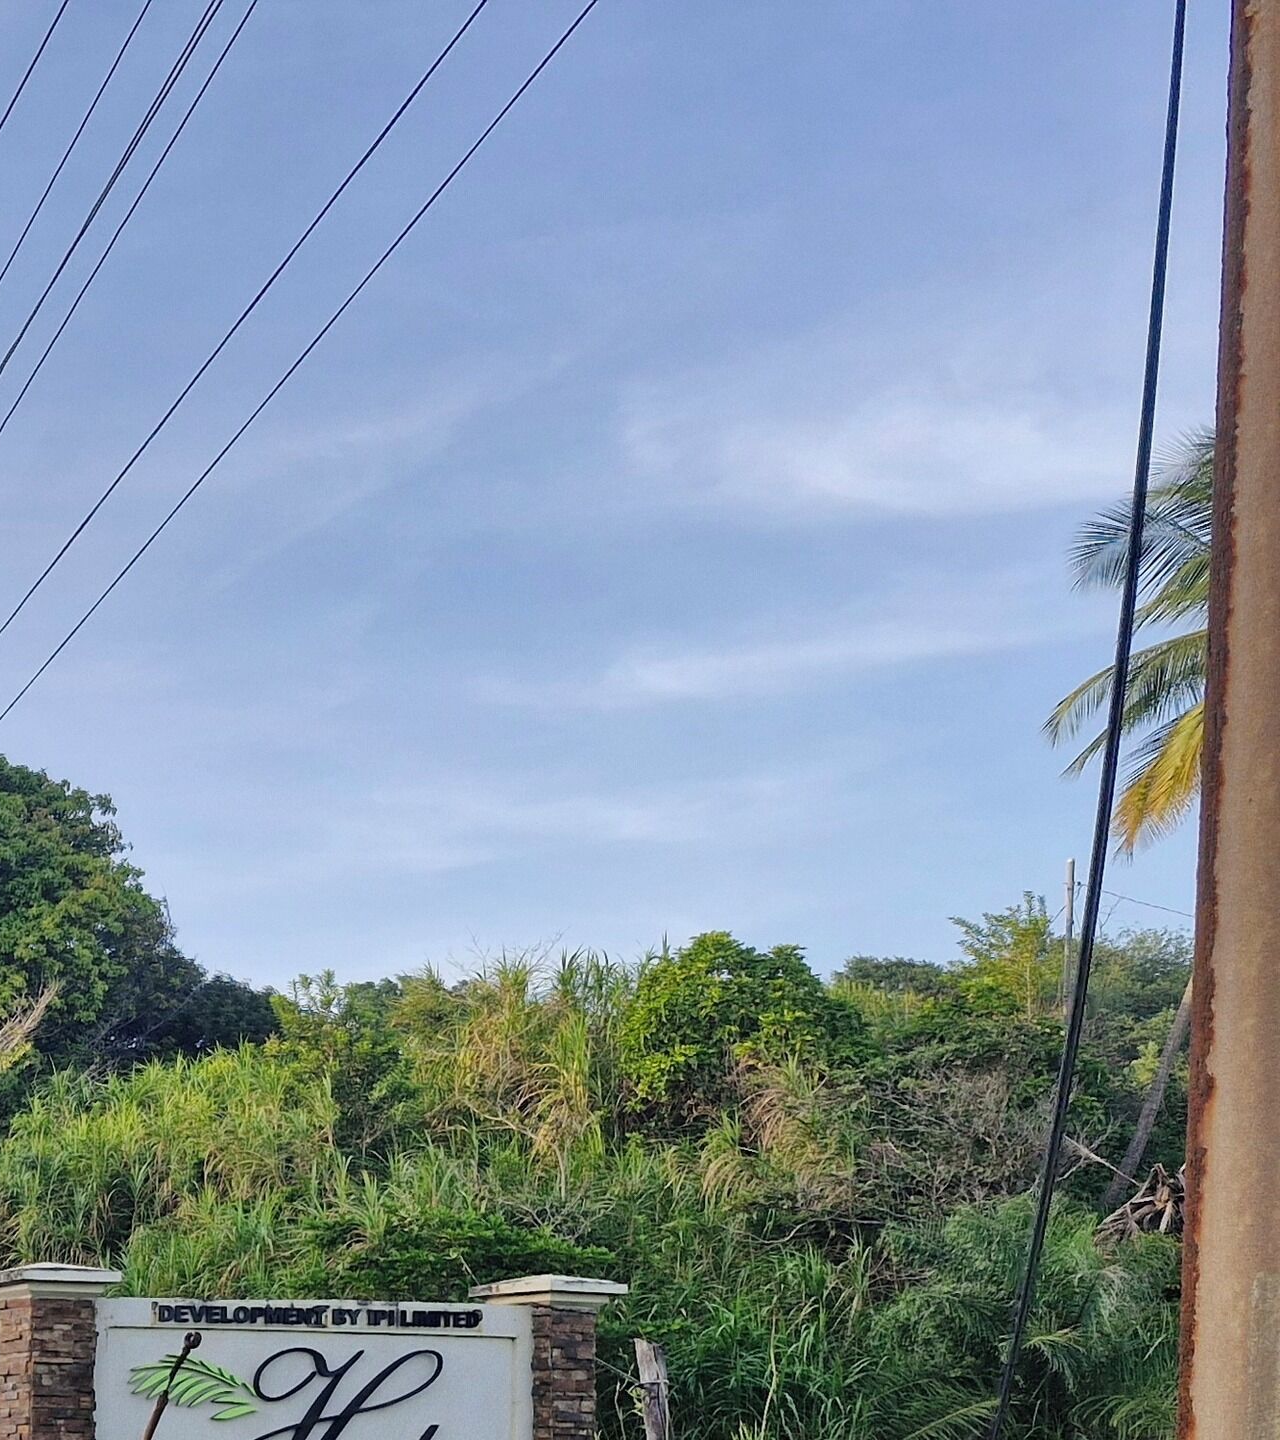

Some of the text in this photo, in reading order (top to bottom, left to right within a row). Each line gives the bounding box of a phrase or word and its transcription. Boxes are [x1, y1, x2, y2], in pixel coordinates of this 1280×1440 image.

[158, 1304, 326, 1327] DEVELOPMENT
[332, 1308, 360, 1326] BY
[400, 1309, 480, 1329] LIMITED
